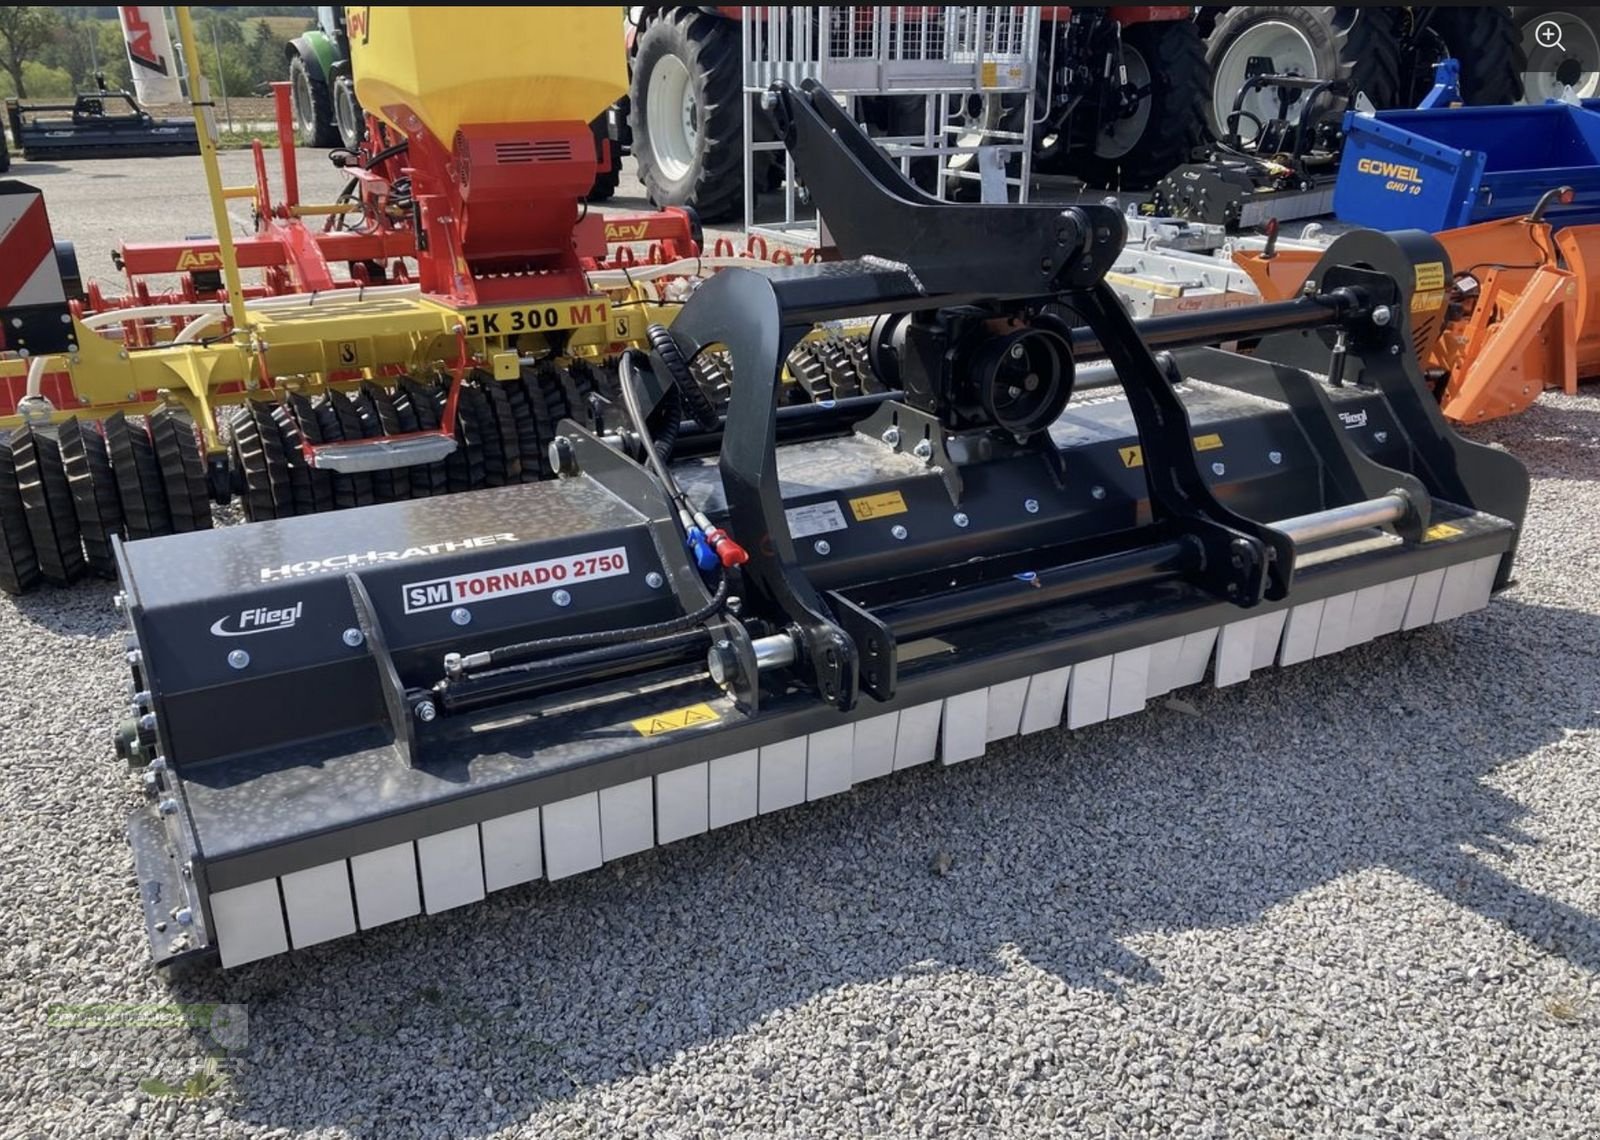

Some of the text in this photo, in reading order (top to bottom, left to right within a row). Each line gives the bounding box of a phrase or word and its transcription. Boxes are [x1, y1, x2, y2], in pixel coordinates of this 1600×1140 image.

[1385, 180, 1421, 196] GHU 10
[606, 223, 645, 239] APV
[511, 308, 558, 331] 300
[569, 303, 607, 326] M1
[259, 532, 520, 580] HOCHRATHER
[410, 553, 625, 607] SM TORNADO 2750
[238, 601, 303, 629] Fliegl
